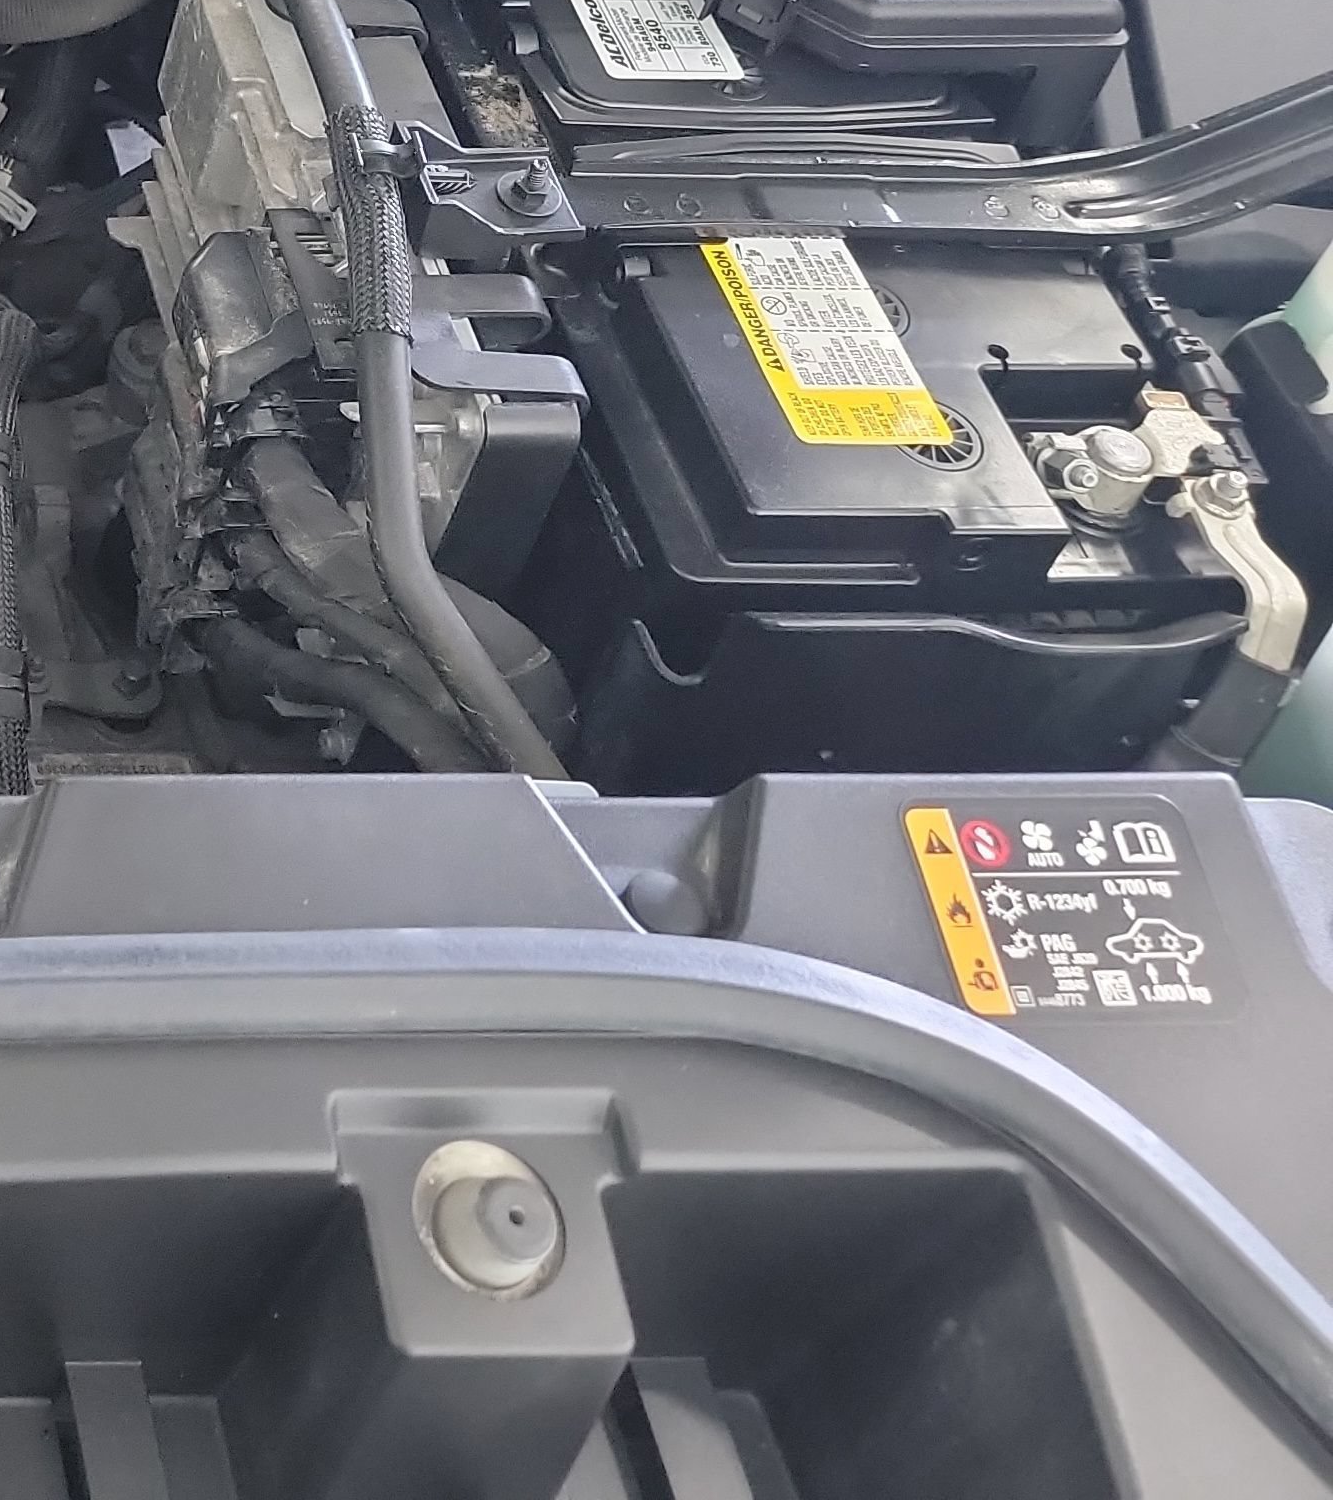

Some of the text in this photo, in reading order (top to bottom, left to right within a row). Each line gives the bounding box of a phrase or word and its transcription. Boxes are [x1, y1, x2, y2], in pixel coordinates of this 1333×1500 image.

[645, 19, 671, 49] 8540
[706, 51, 720, 66] 730
[712, 250, 776, 356] DANGER/POISON
[1028, 852, 1064, 867] AUTO
[1103, 879, 1172, 898] 0.700 kg
[1027, 893, 1098, 913] R-1234yf
[1040, 934, 1077, 952] PAG
[1140, 984, 1212, 1004] 1.000 kg
